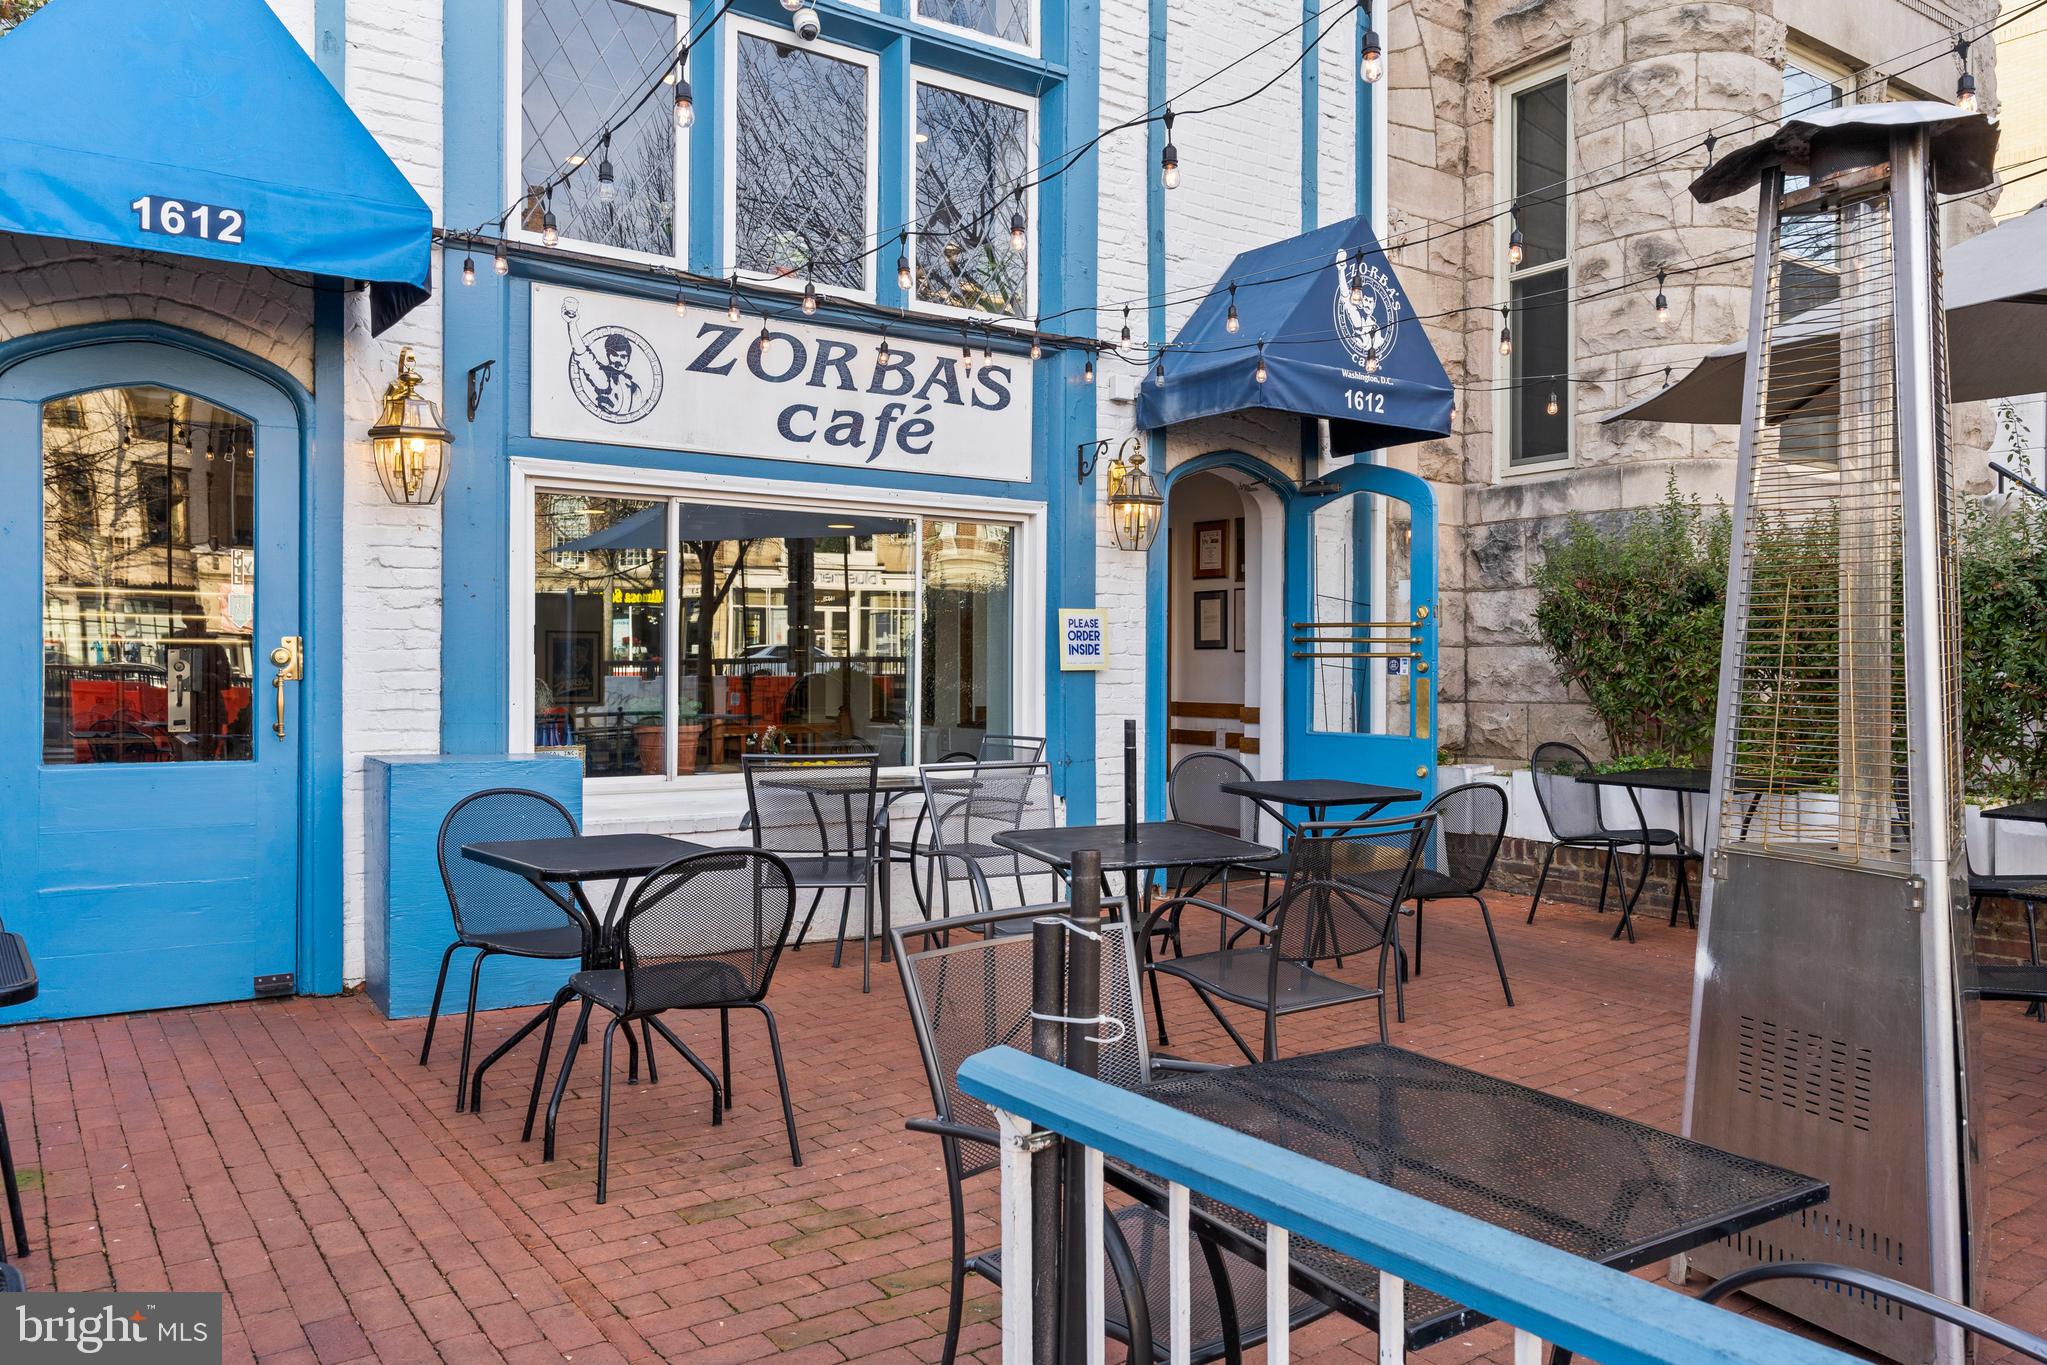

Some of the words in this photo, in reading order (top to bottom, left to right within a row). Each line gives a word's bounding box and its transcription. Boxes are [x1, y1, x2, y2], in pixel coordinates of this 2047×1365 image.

[133, 196, 242, 243] 1612
[685, 322, 1011, 411] ZORBA'S
[1341, 369, 1380, 383] Washington,
[1345, 389, 1384, 413] 1612
[777, 402, 935, 463] café
[233, 549, 242, 584] PULL
[1068, 618, 1099, 628] PLEASE
[1067, 630, 1101, 641] ORDER
[1068, 643, 1101, 655] INSIDE
